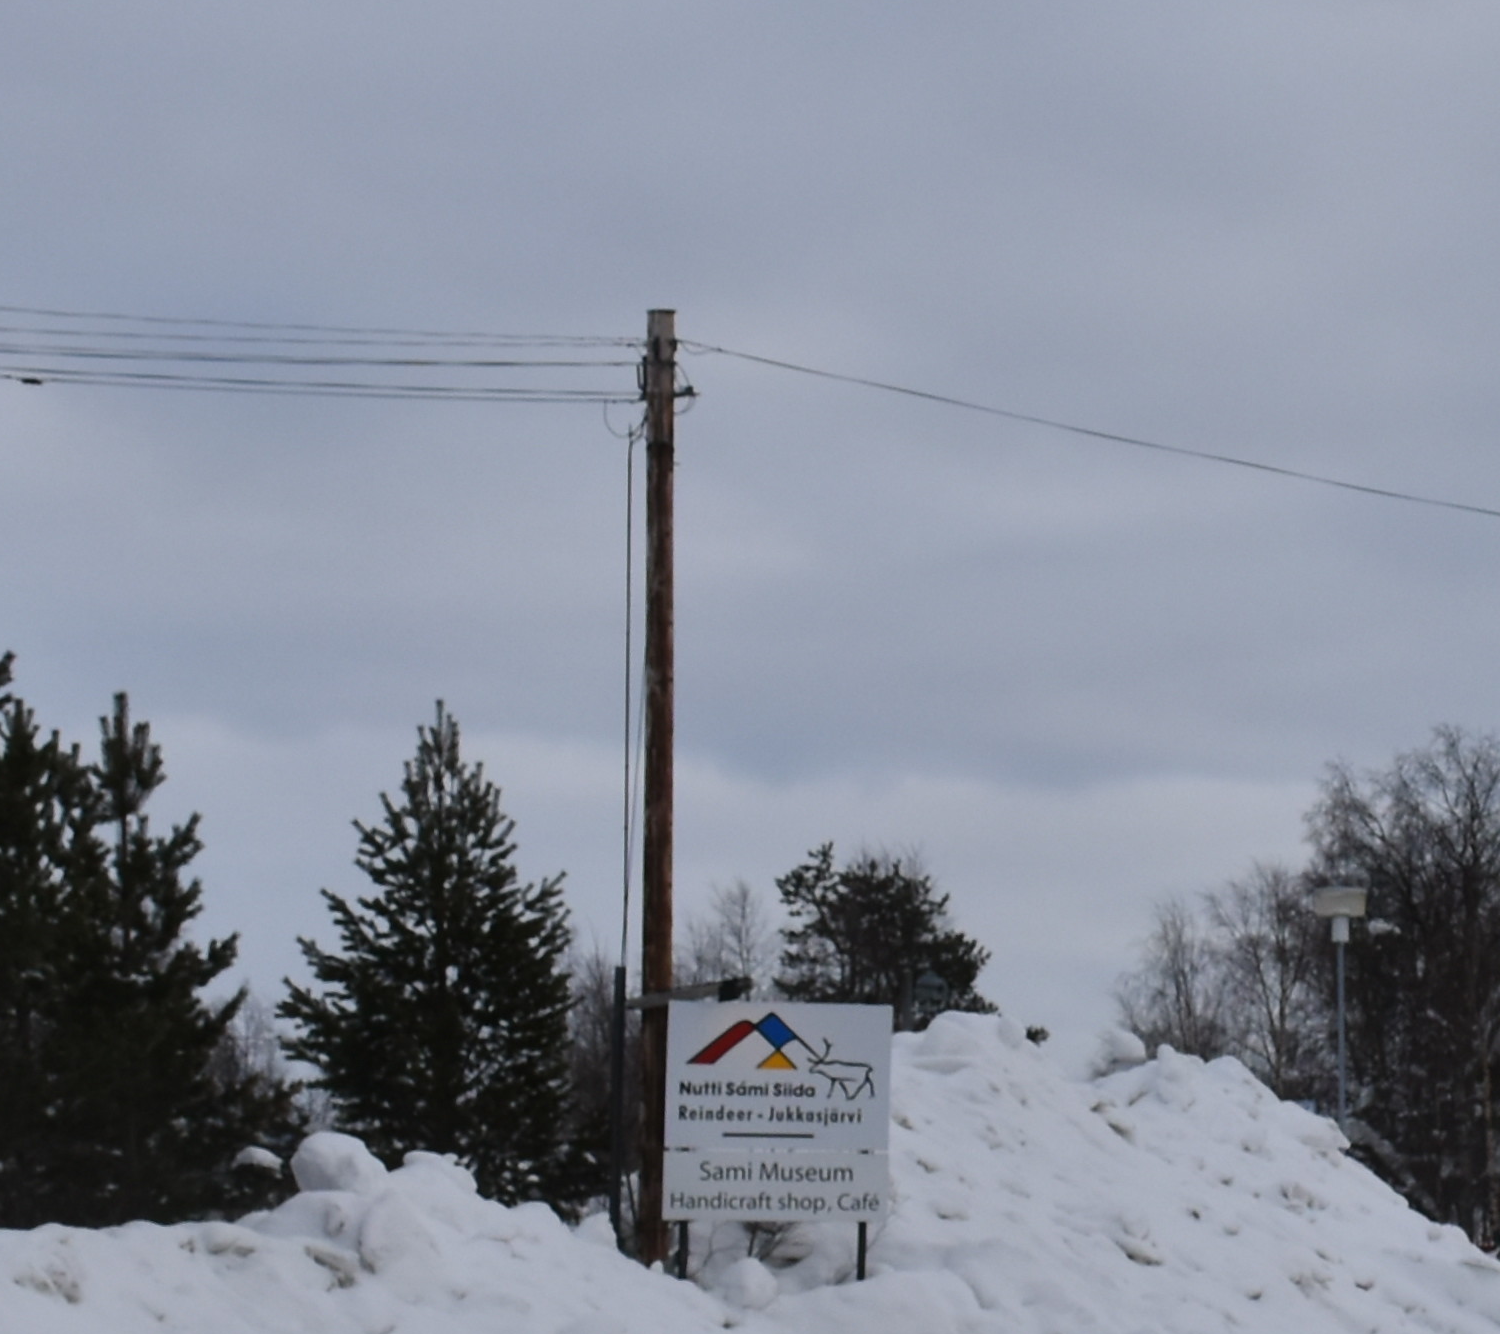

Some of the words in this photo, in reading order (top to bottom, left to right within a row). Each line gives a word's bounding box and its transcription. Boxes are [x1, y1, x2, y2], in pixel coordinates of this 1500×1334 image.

[679, 1081, 722, 1096] Nutti
[726, 1081, 769, 1097] Sámi
[773, 1082, 816, 1098] Siida
[678, 1105, 753, 1121] Reindeer
[768, 1106, 862, 1126] Jukkasjärvi
[699, 1161, 752, 1181] Sami
[759, 1162, 854, 1182] Museum
[670, 1192, 772, 1212] Handicraft
[777, 1194, 831, 1214] shop,
[837, 1193, 880, 1211] Café
